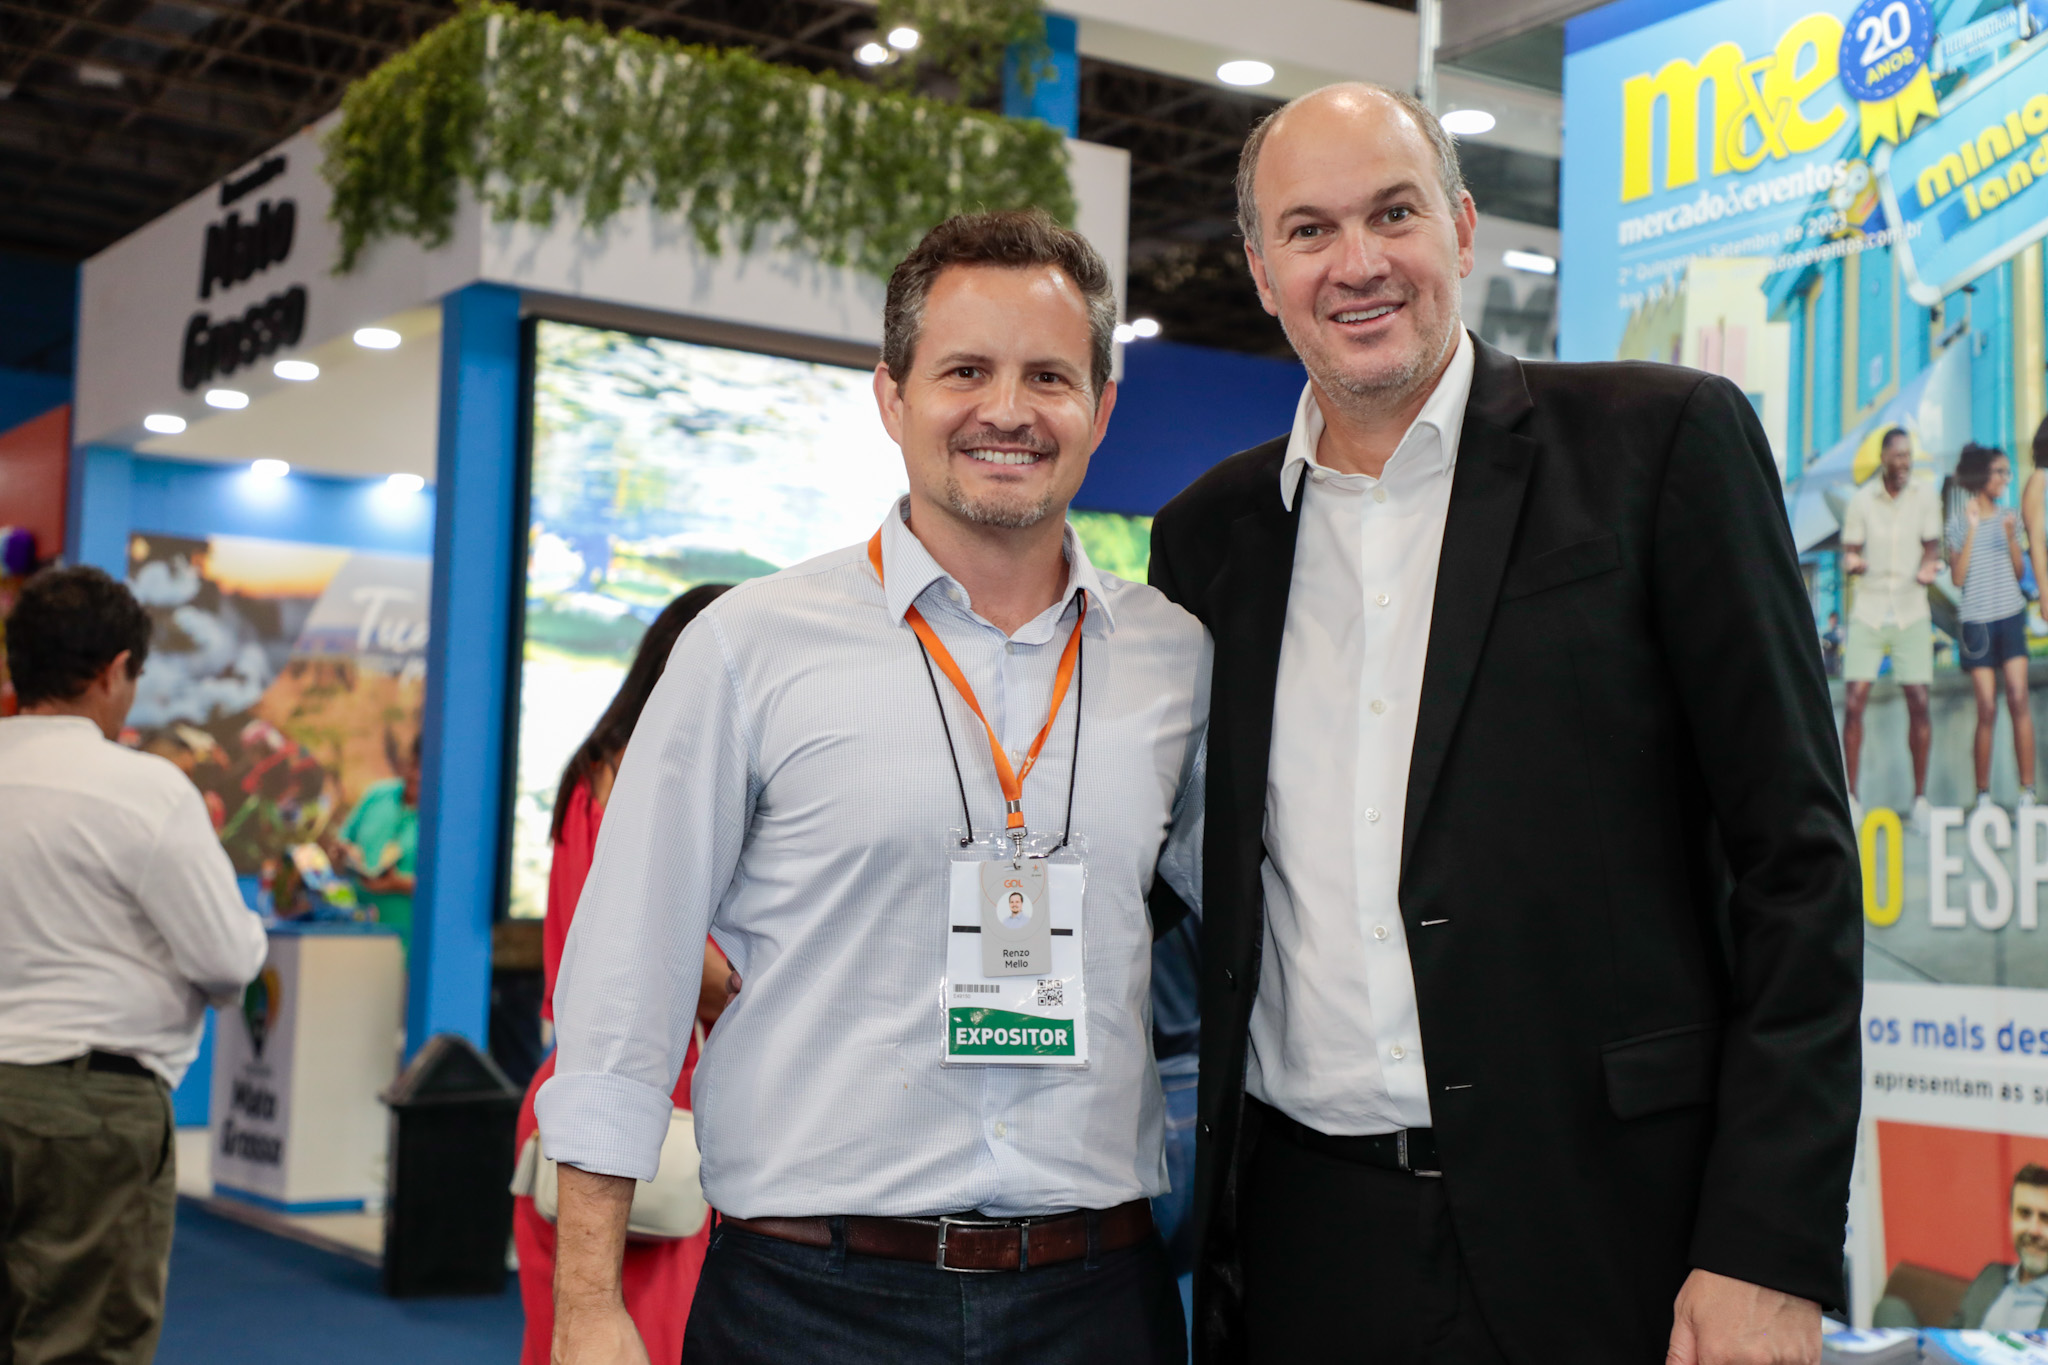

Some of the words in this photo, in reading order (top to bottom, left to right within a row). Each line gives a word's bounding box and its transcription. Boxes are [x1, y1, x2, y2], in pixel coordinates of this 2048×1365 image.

[1856, 1, 1912, 67] 20
[1865, 45, 1916, 87] ANOS
[1621, 12, 1848, 203] m&e
[1619, 158, 1849, 246] mercado&eventos
[1003, 879, 1024, 889] GOL
[1003, 948, 1030, 958] Renzo
[1005, 959, 1029, 969] Mello
[955, 1027, 1068, 1047] EXPOSITOR
[1868, 1017, 1901, 1044] os
[1912, 1013, 1985, 1051] mais
[1874, 1071, 1993, 1100] apresentam
